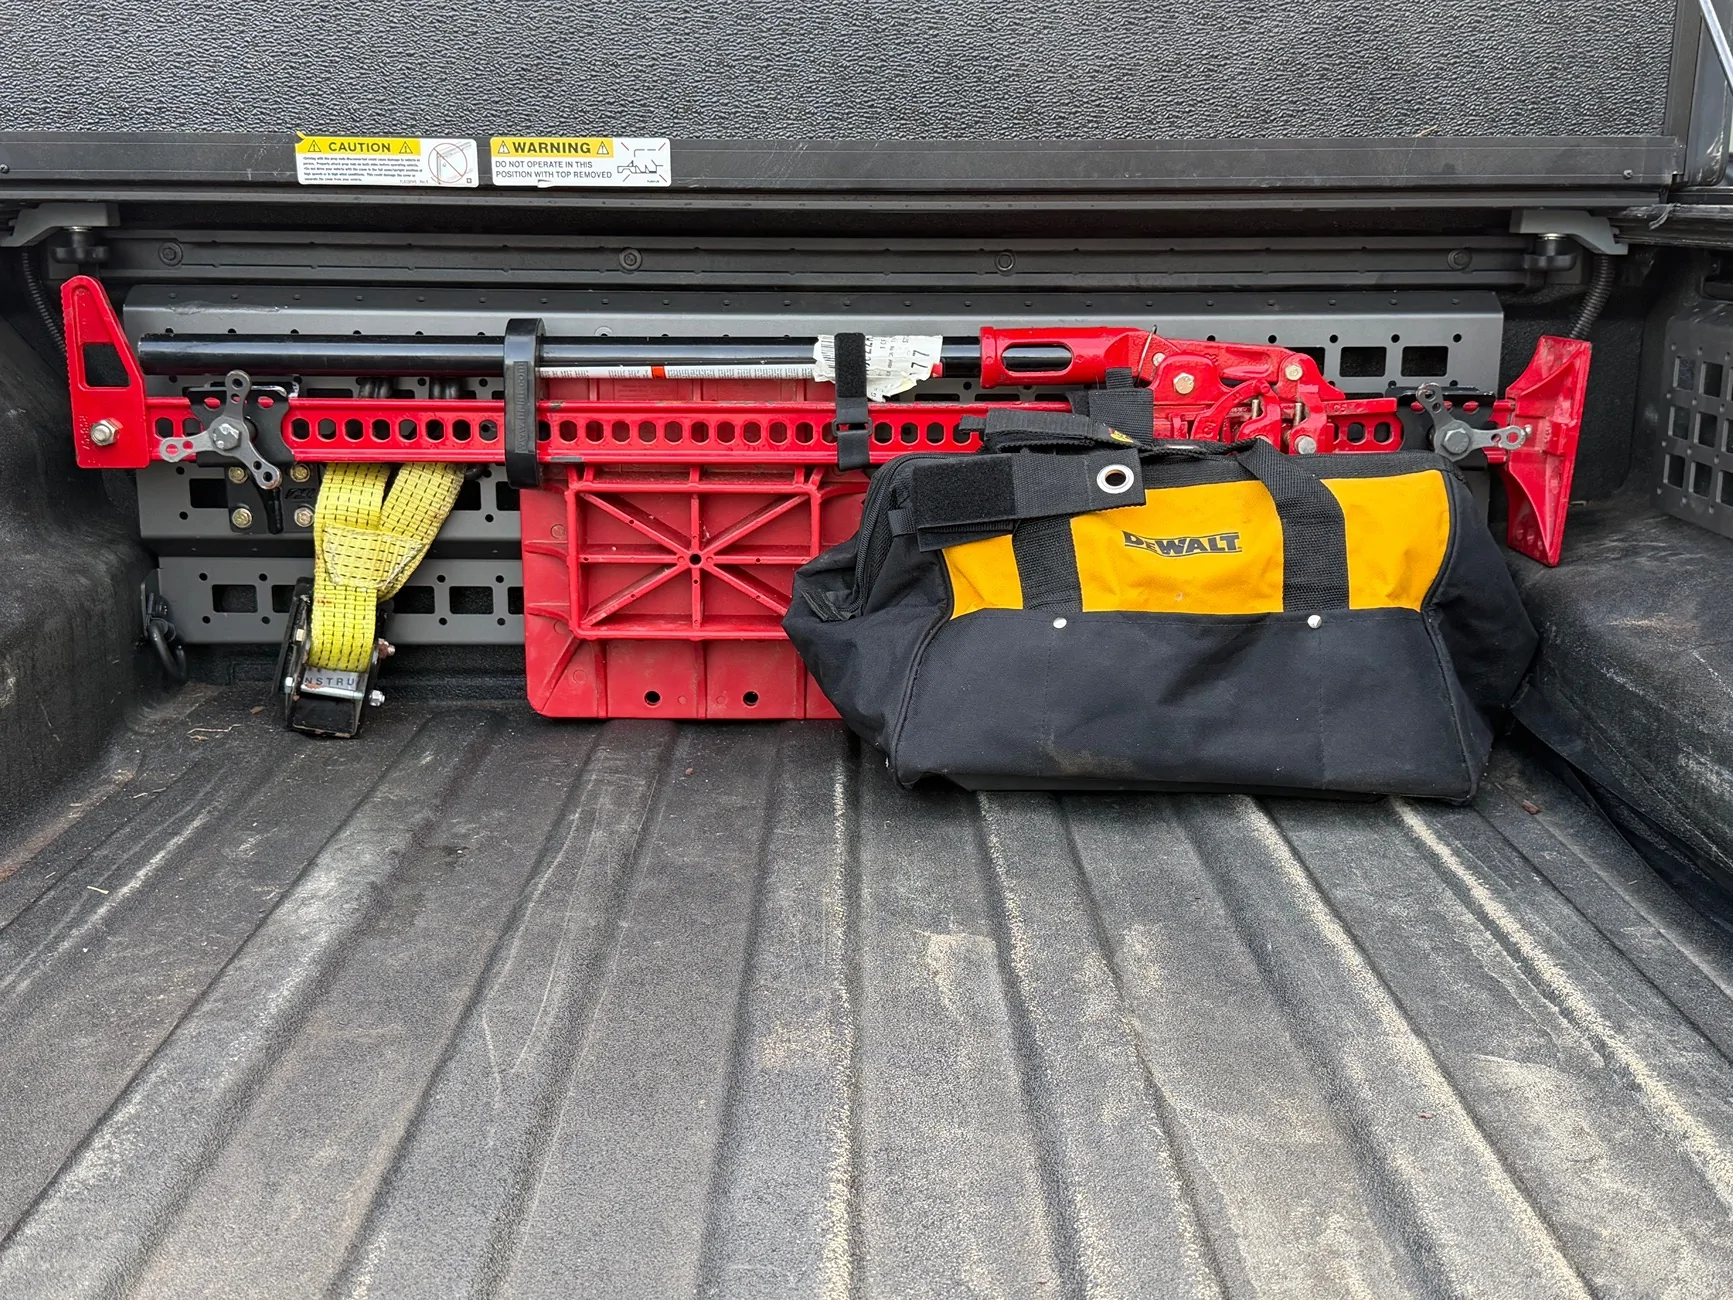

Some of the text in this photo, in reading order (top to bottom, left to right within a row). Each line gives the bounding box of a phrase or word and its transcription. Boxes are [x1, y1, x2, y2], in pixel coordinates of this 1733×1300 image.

[328, 142, 391, 153] CAUTION
[512, 142, 591, 154] WARNING
[495, 160, 507, 168] DO
[508, 160, 526, 168] NOT
[526, 160, 564, 169] OPERATE
[575, 161, 593, 169] THIS
[1121, 530, 1240, 555] DEWALT
